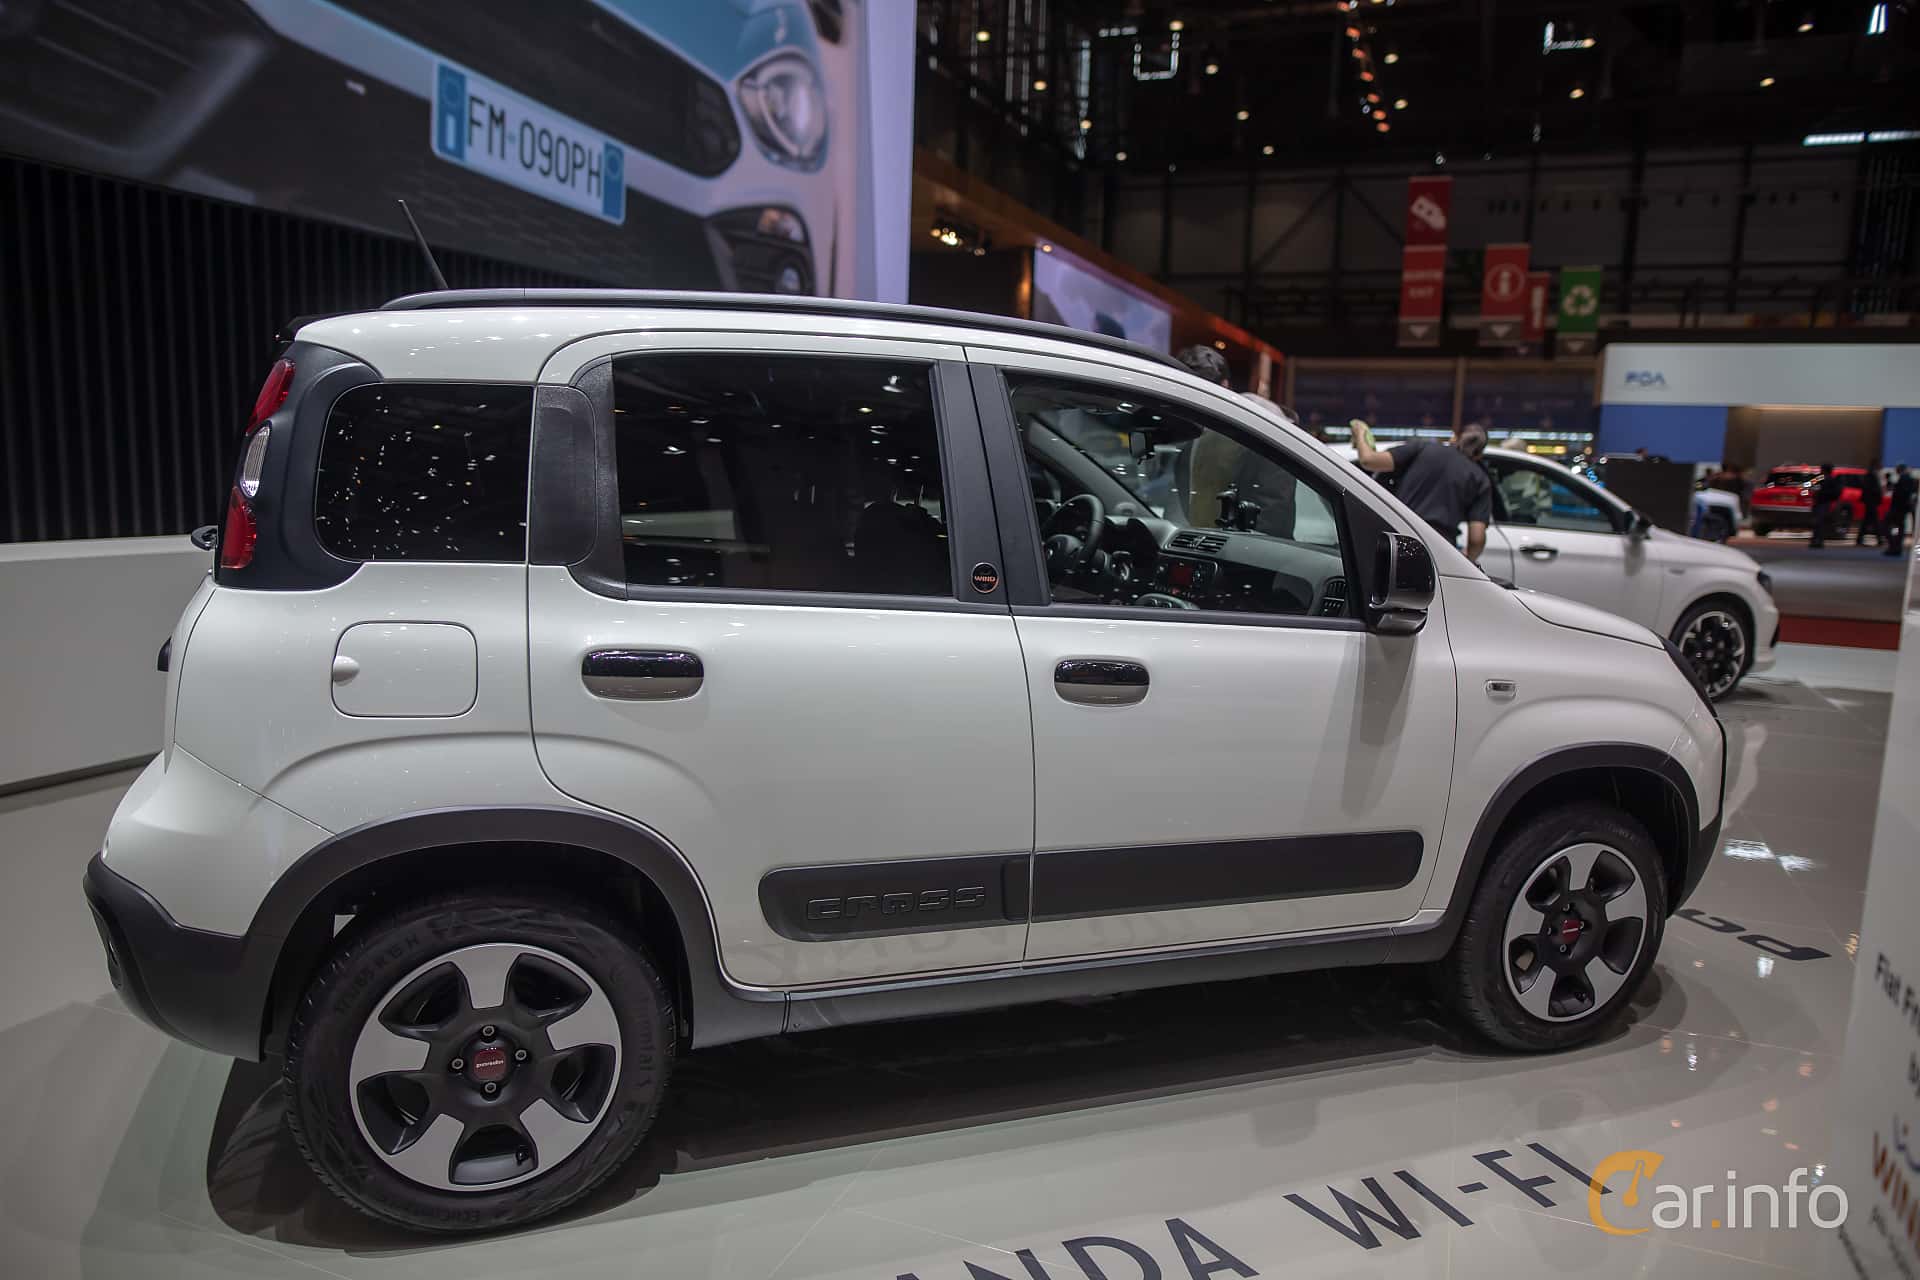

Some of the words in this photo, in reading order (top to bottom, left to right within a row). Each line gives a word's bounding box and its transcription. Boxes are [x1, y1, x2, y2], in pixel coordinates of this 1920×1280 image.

[467, 95, 506, 160] FM
[807, 886, 985, 921] cross
[1283, 1142, 1613, 1250] WI-FI
